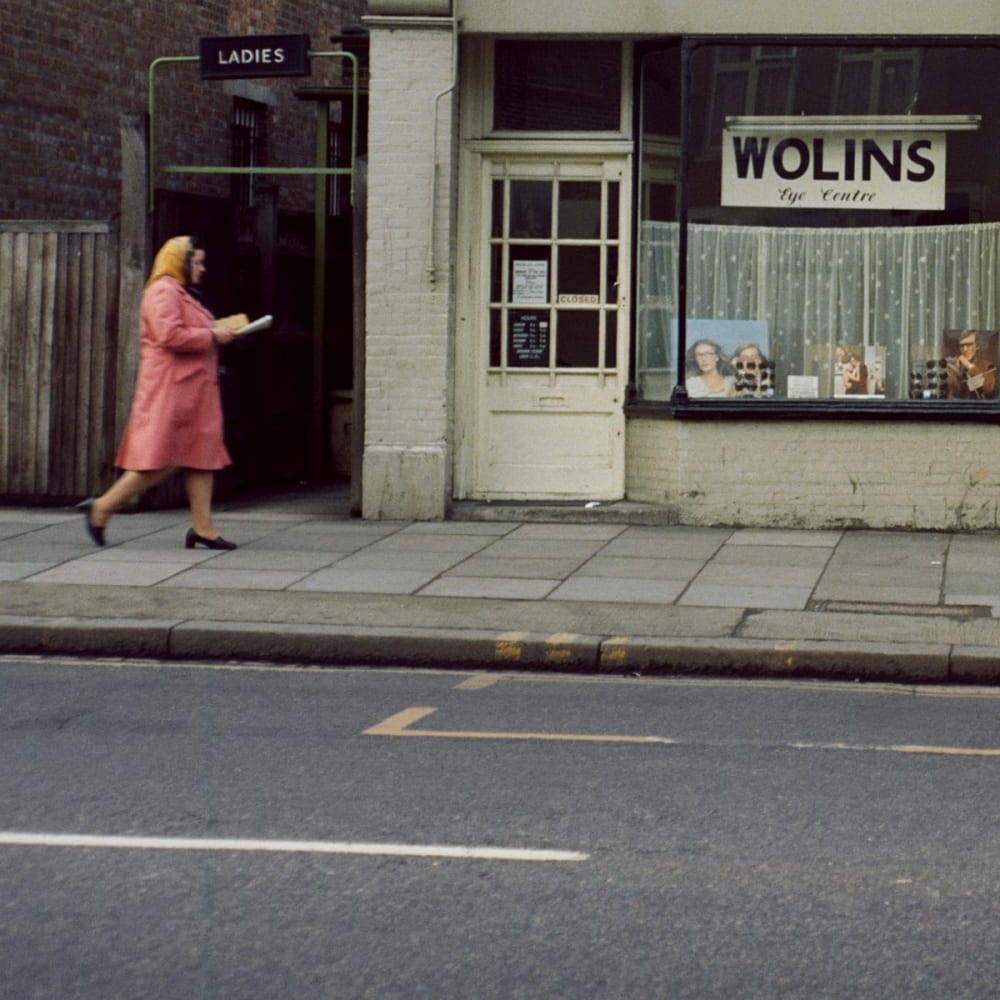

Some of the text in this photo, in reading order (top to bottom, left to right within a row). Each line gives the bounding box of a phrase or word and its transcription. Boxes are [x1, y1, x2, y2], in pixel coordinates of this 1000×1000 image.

[218, 48, 285, 65] LADIES
[733, 136, 936, 182] WOLINS
[777, 186, 877, 206] Eye Centre
[561, 296, 596, 304] CLOSED
